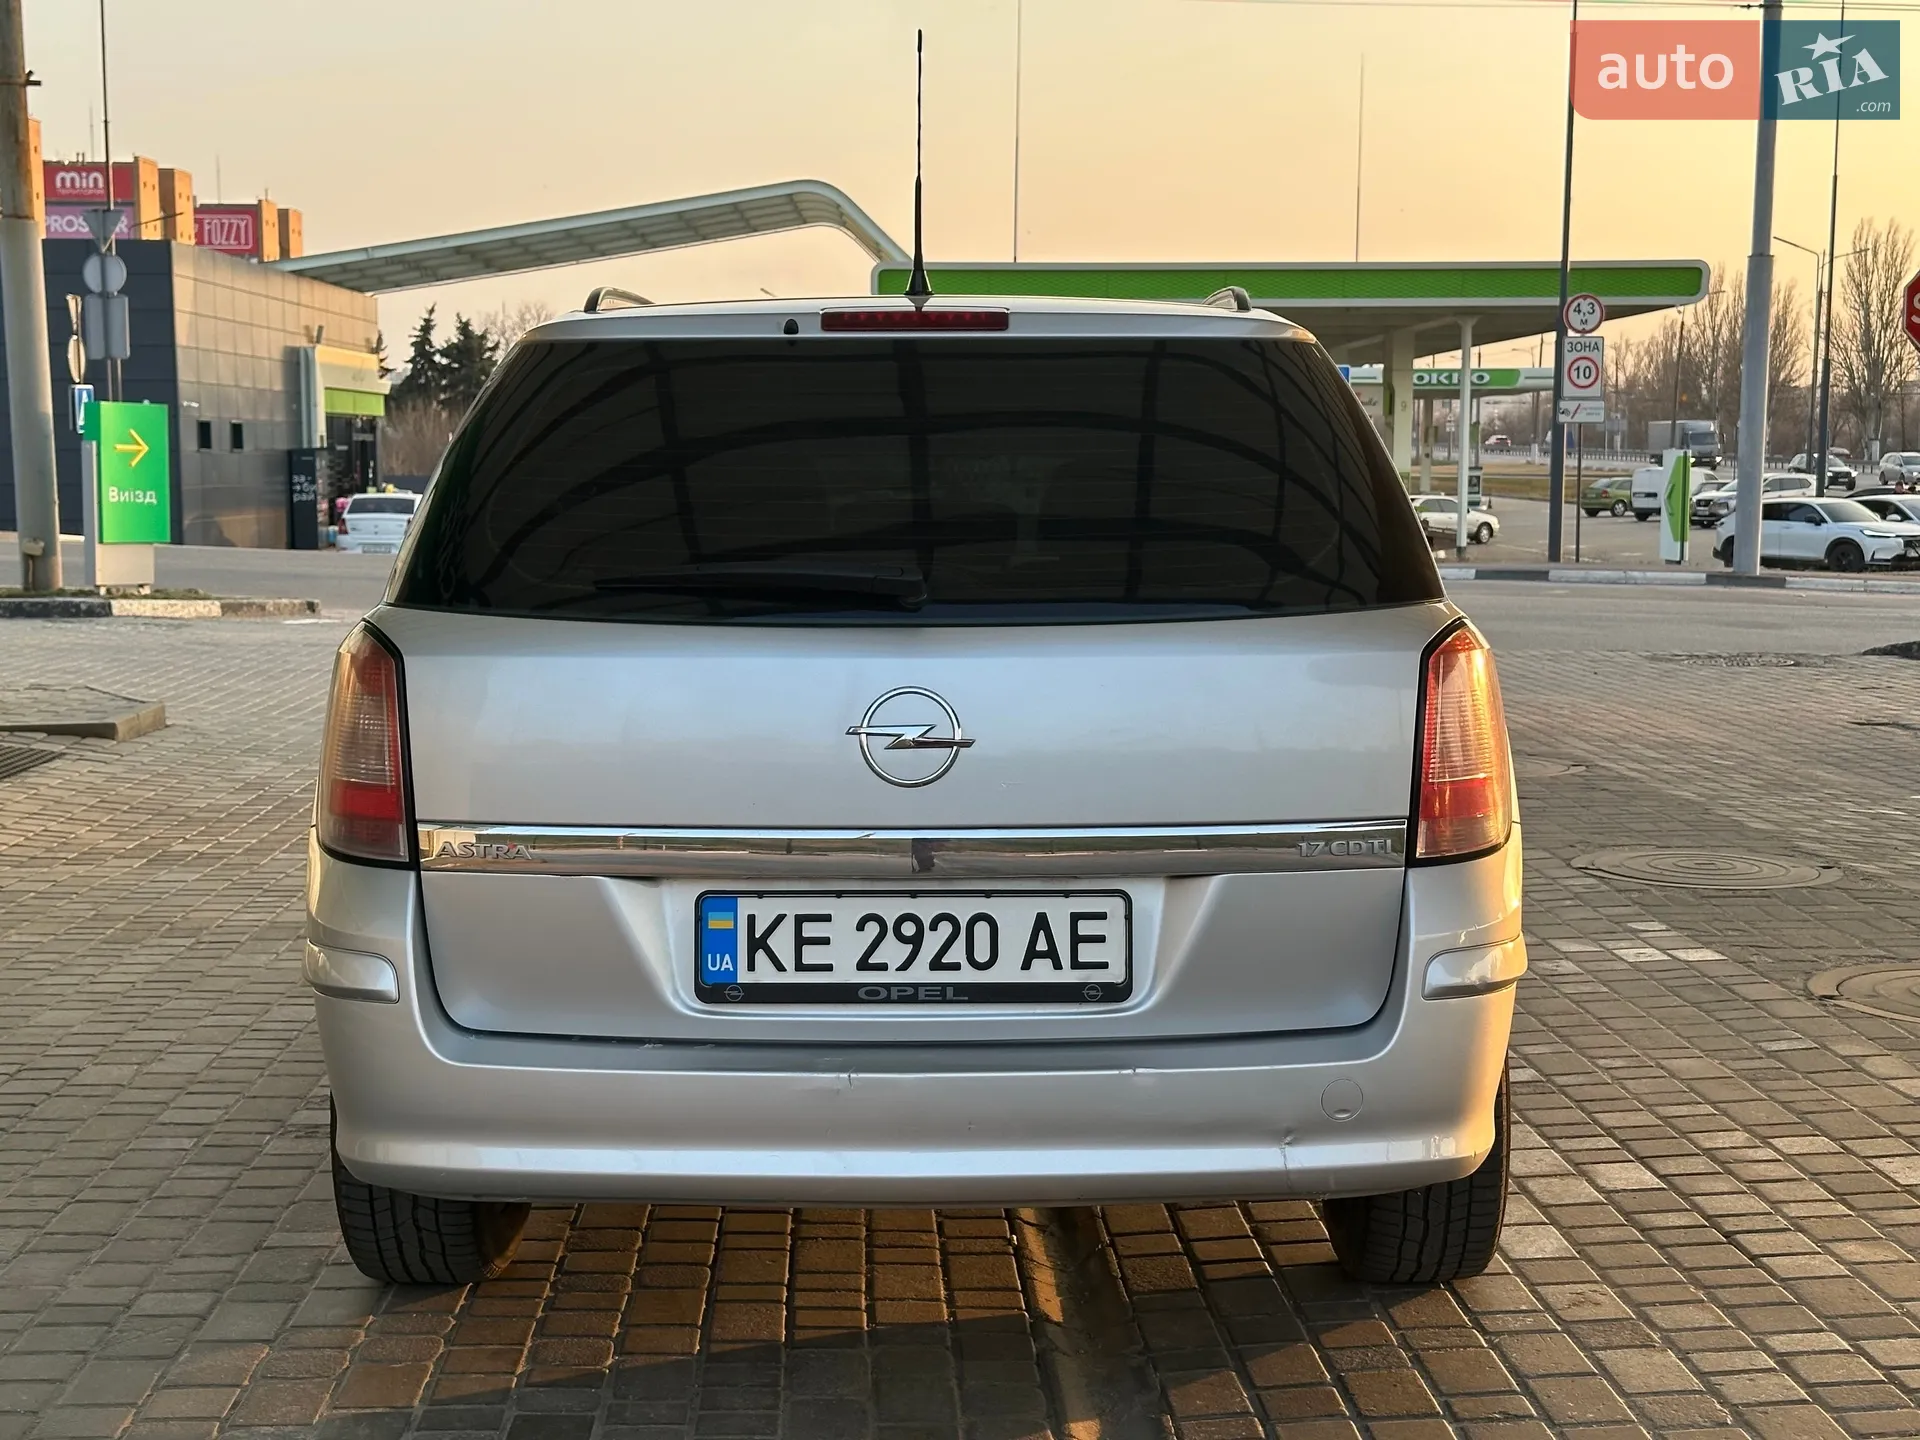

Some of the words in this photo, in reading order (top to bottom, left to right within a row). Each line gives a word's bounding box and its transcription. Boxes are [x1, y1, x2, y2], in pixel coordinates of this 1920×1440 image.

[55, 171, 105, 189] min
[46, 214, 128, 233] ROSR
[203, 218, 247, 245] FOZZY
[1573, 302, 1595, 317] 4,3
[1567, 341, 1600, 353] ЗОНА
[1573, 365, 1592, 380] 10
[109, 486, 157, 504] Виїзд
[436, 841, 532, 860] ASTRA
[1329, 839, 1392, 856] CDTI
[747, 913, 834, 972] KE
[856, 912, 999, 971] 2920
[1020, 911, 1110, 971] AE
[708, 954, 734, 971] UA
[857, 986, 969, 1001] OPEL
